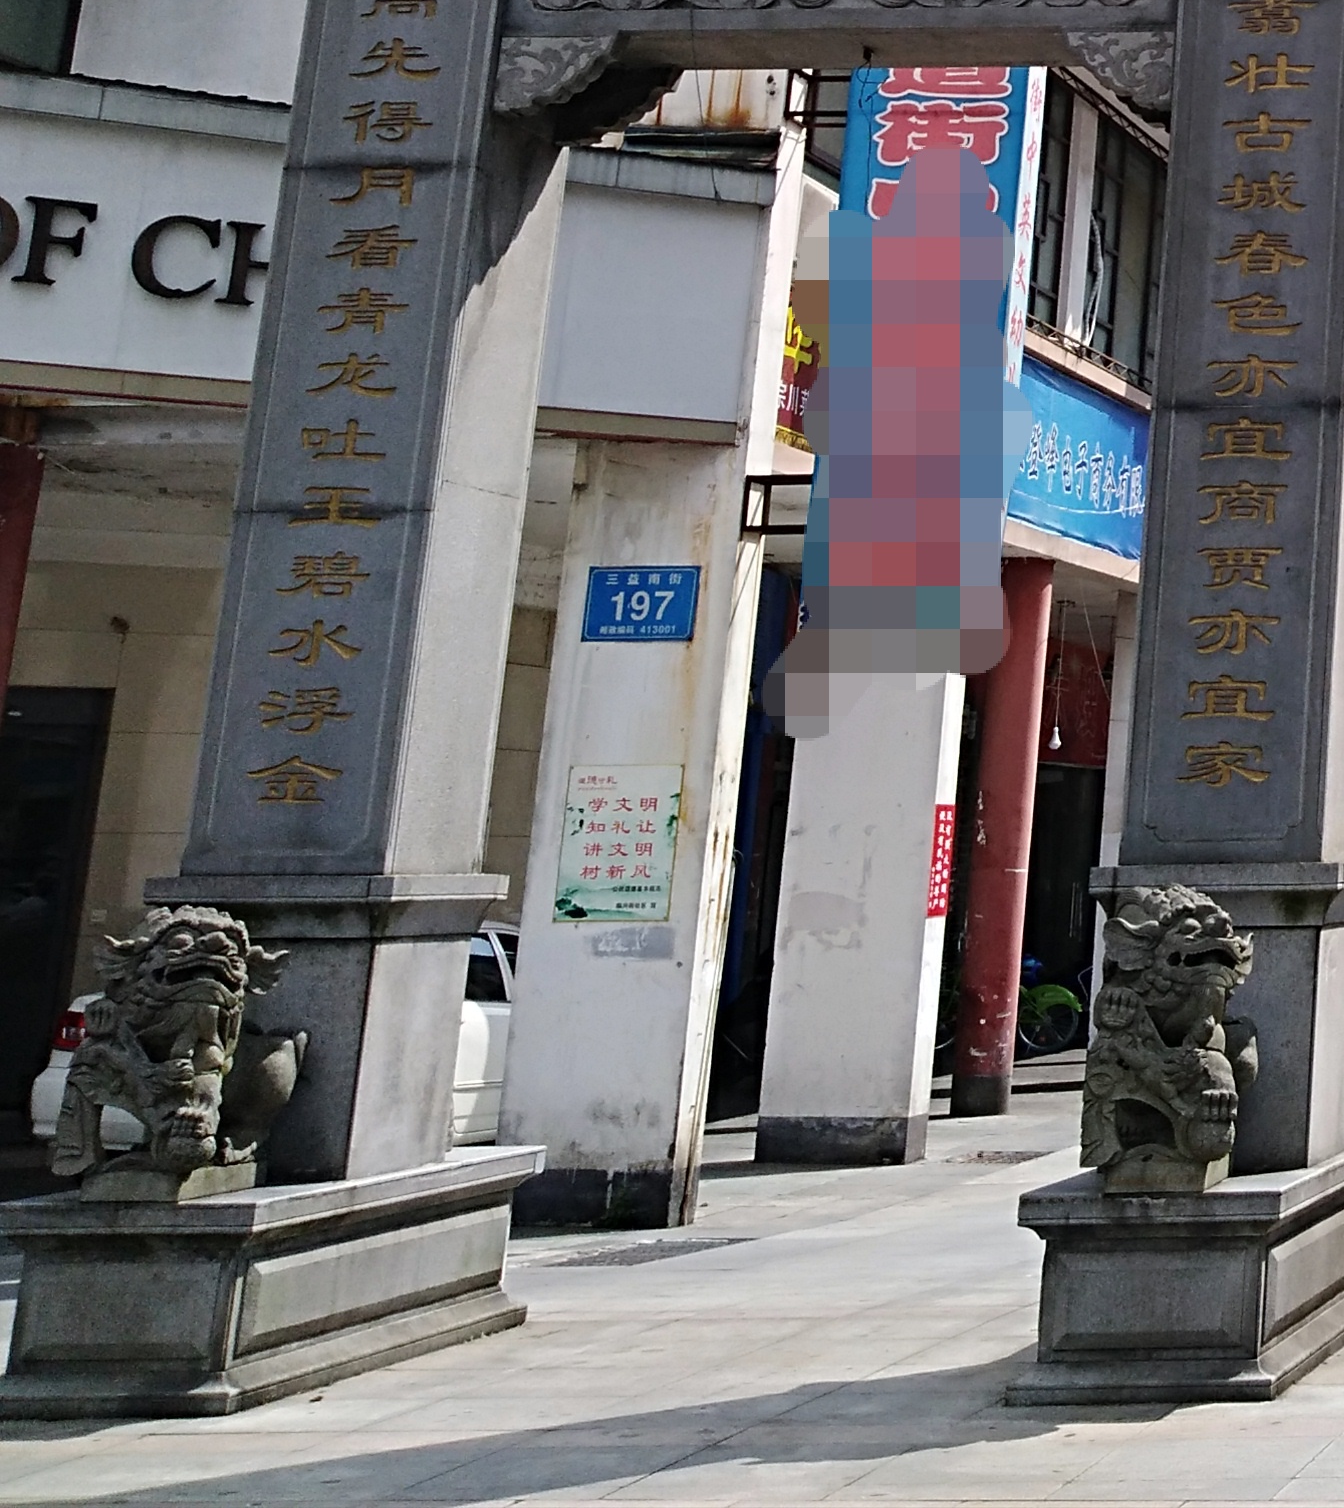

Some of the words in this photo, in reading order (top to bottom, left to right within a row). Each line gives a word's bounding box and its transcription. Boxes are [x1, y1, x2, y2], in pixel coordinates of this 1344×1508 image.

[1007, 77, 1043, 383] 街中英文幼
[0, 195, 98, 285] F
[611, 590, 675, 621] 197
[640, 625, 676, 634] 413001
[588, 797, 658, 813] 学文明
[585, 819, 656, 835] 知礼让
[583, 842, 654, 858] 讲文明
[579, 864, 651, 880] 树新风
